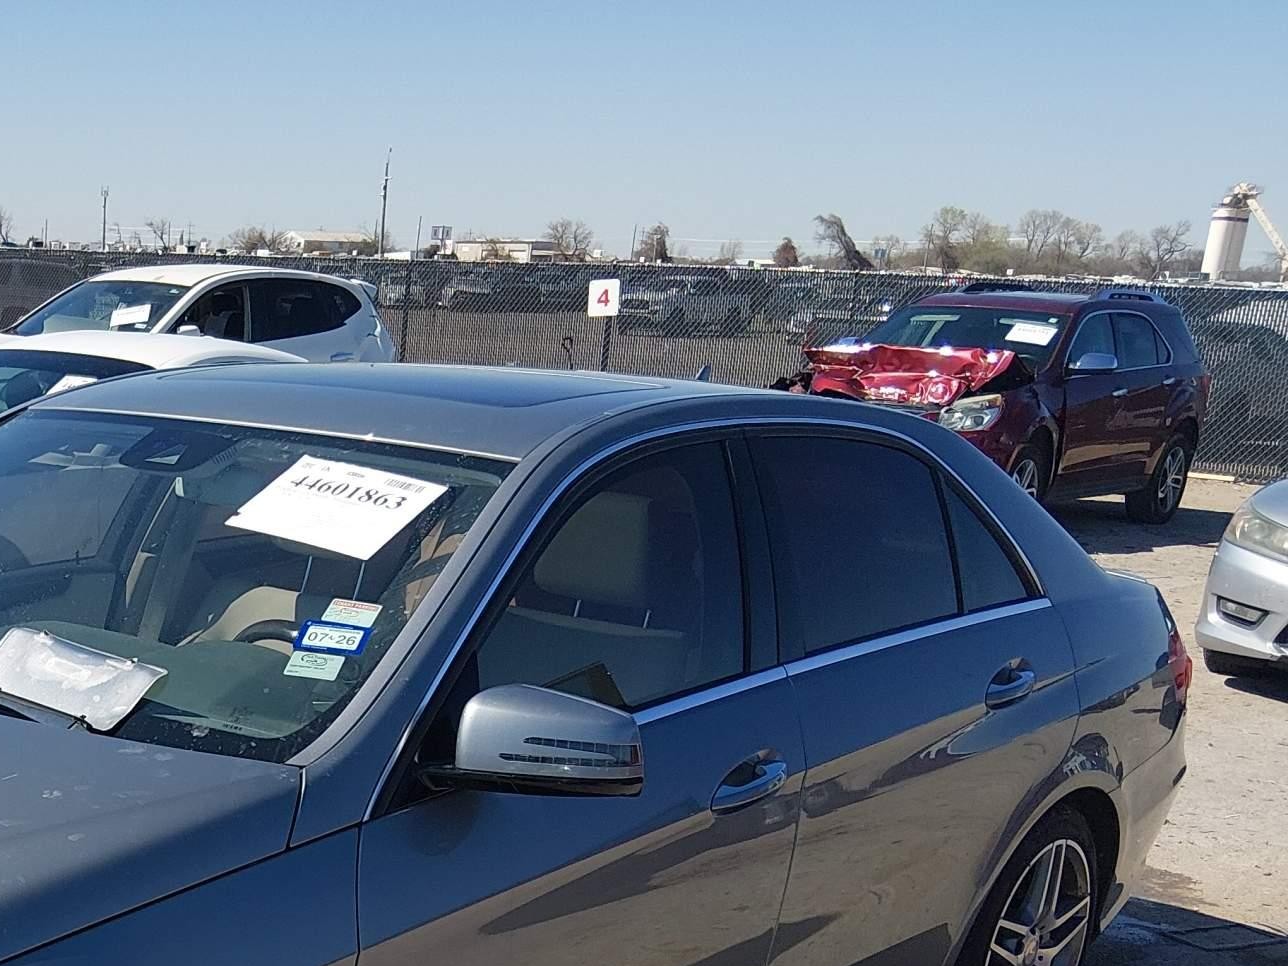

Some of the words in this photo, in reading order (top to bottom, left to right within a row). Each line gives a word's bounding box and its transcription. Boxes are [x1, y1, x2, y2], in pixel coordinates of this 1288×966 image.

[597, 288, 610, 307] 4
[290, 475, 408, 510] 44601863
[307, 631, 329, 642] 07
[336, 634, 357, 646] 26
